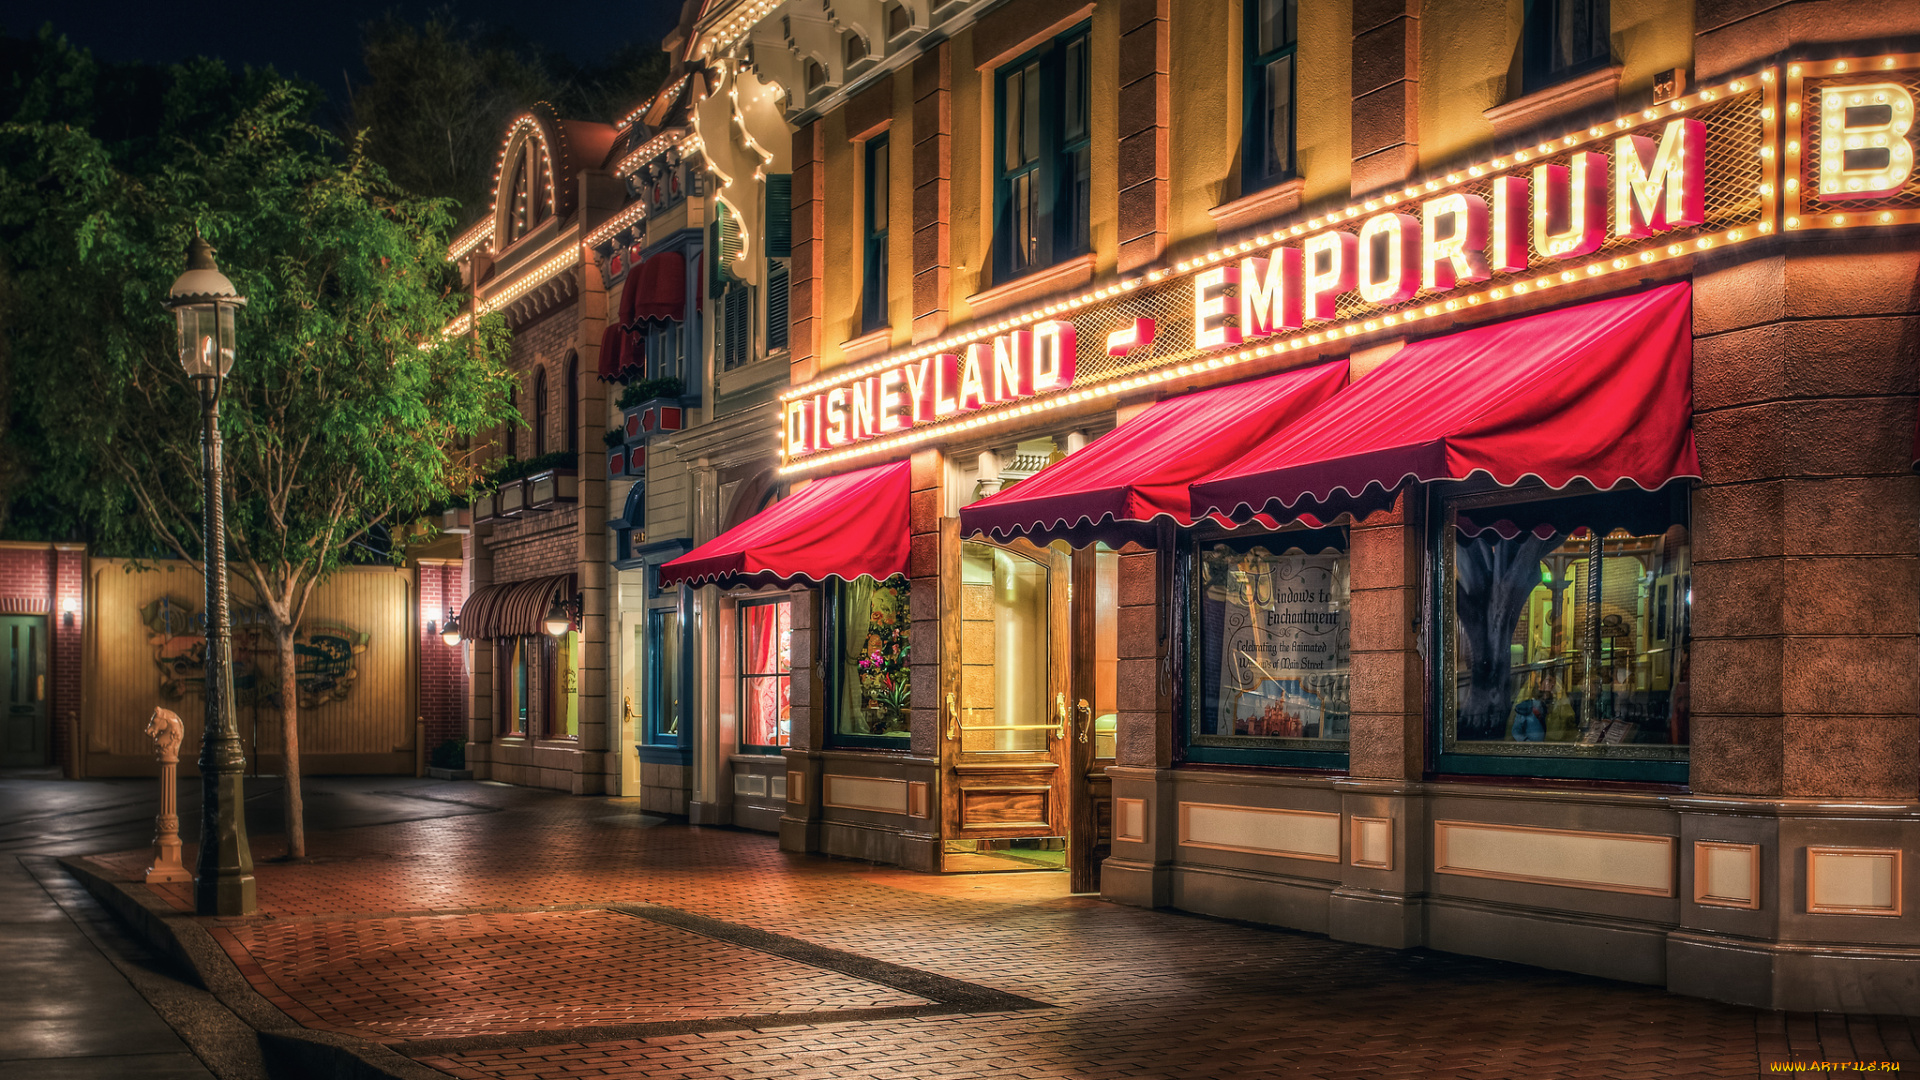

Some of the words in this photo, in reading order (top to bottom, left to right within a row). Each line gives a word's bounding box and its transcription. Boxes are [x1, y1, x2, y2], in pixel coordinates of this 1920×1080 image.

[1819, 82, 1915, 201] B
[788, 320, 1076, 455] DISNEYLAND
[1195, 118, 1706, 350] EMPORIUM
[1267, 608, 1340, 626] Enchantment
[1236, 640, 1277, 656] Celebrating
[1280, 641, 1290, 652] the
[1292, 641, 1327, 652] Animated
[1239, 658, 1272, 668] Wows
[1300, 656, 1324, 669] Street
